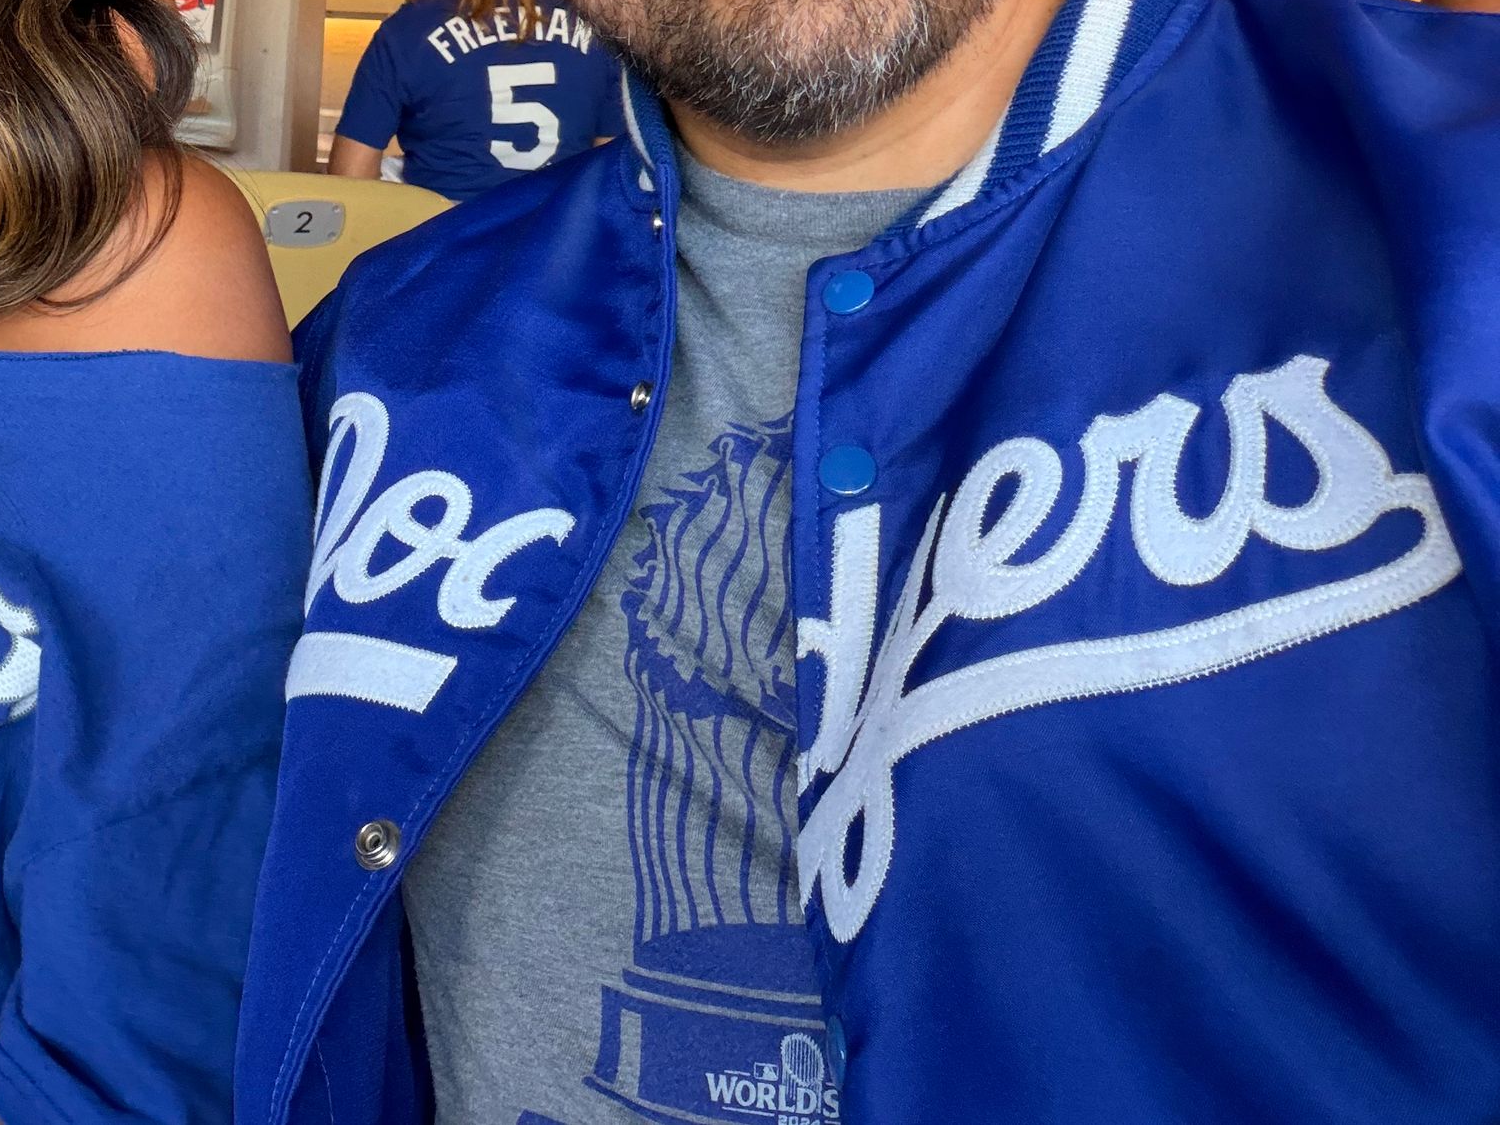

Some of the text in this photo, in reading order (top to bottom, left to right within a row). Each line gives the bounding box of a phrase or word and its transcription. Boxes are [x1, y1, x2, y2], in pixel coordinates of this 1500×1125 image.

[487, 61, 560, 172] 5
[294, 211, 313, 233] 2
[705, 1072, 840, 1119] WORLD S
